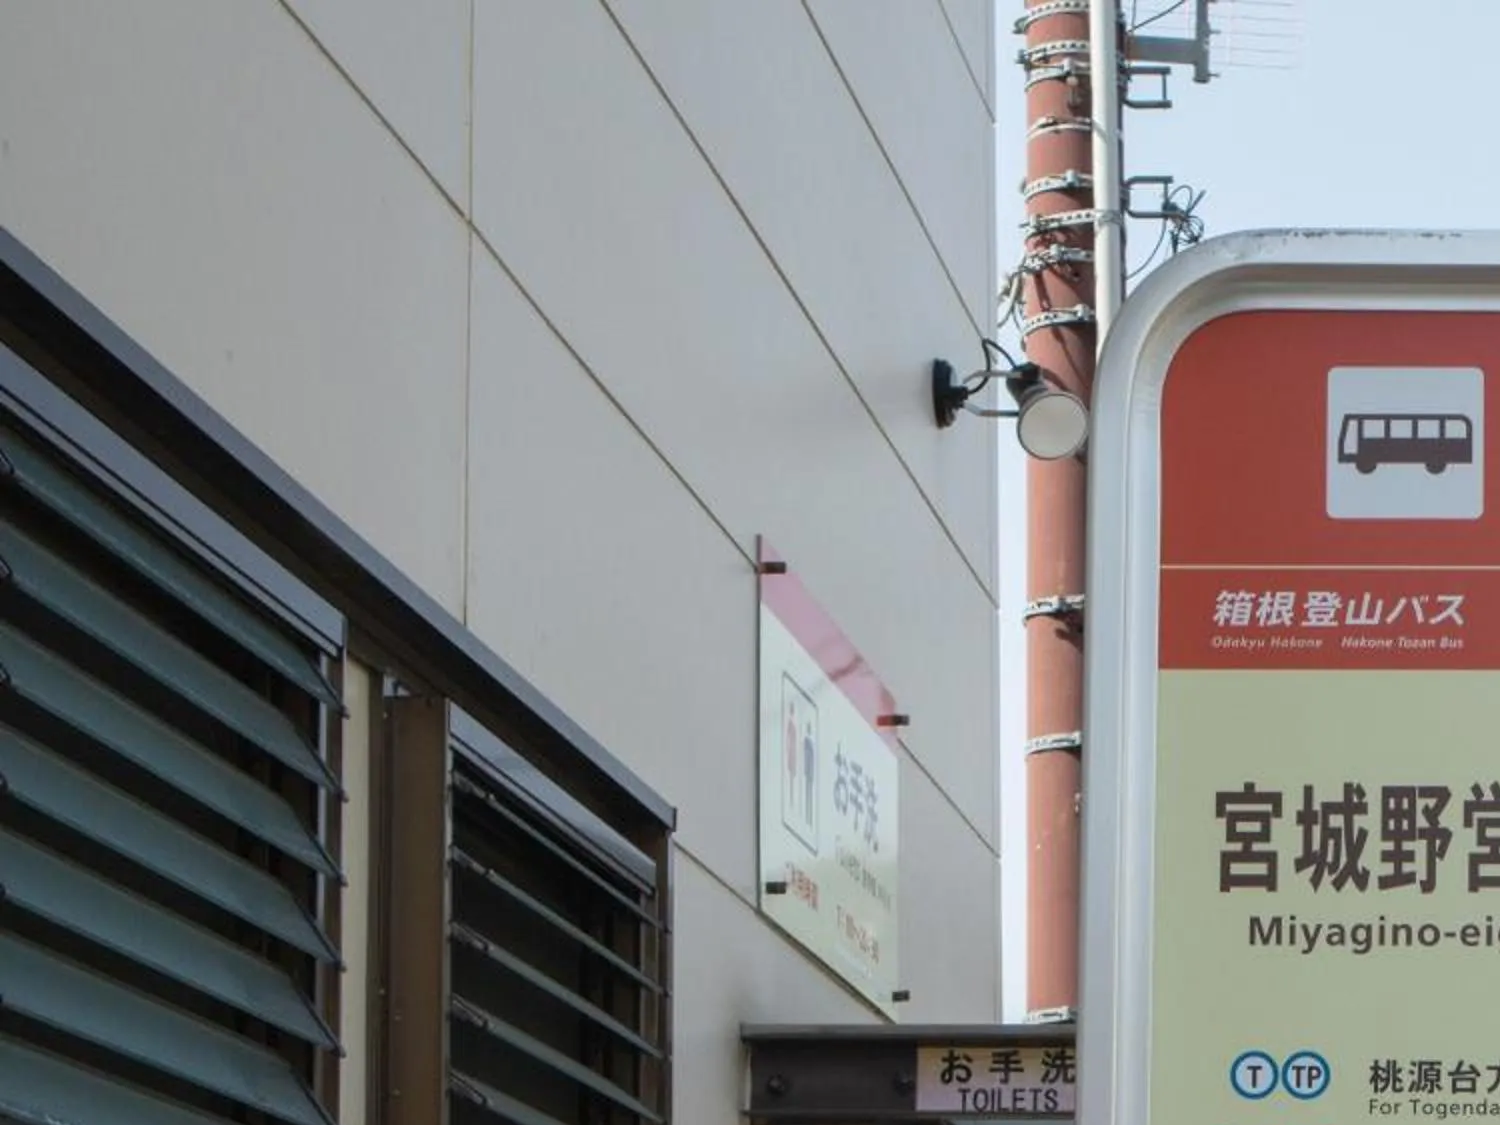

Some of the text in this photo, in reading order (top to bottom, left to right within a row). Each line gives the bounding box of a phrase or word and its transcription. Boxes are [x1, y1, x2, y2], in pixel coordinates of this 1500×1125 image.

[1213, 589, 1466, 628] 箱根登山バス
[1211, 634, 1323, 650] Odakyu Hakone
[1341, 634, 1463, 648] Hakone Tozan Bus
[1291, 1065, 1323, 1089] TP
[957, 1088, 1060, 1112] TOILETS
[1368, 1099, 1401, 1115] For
